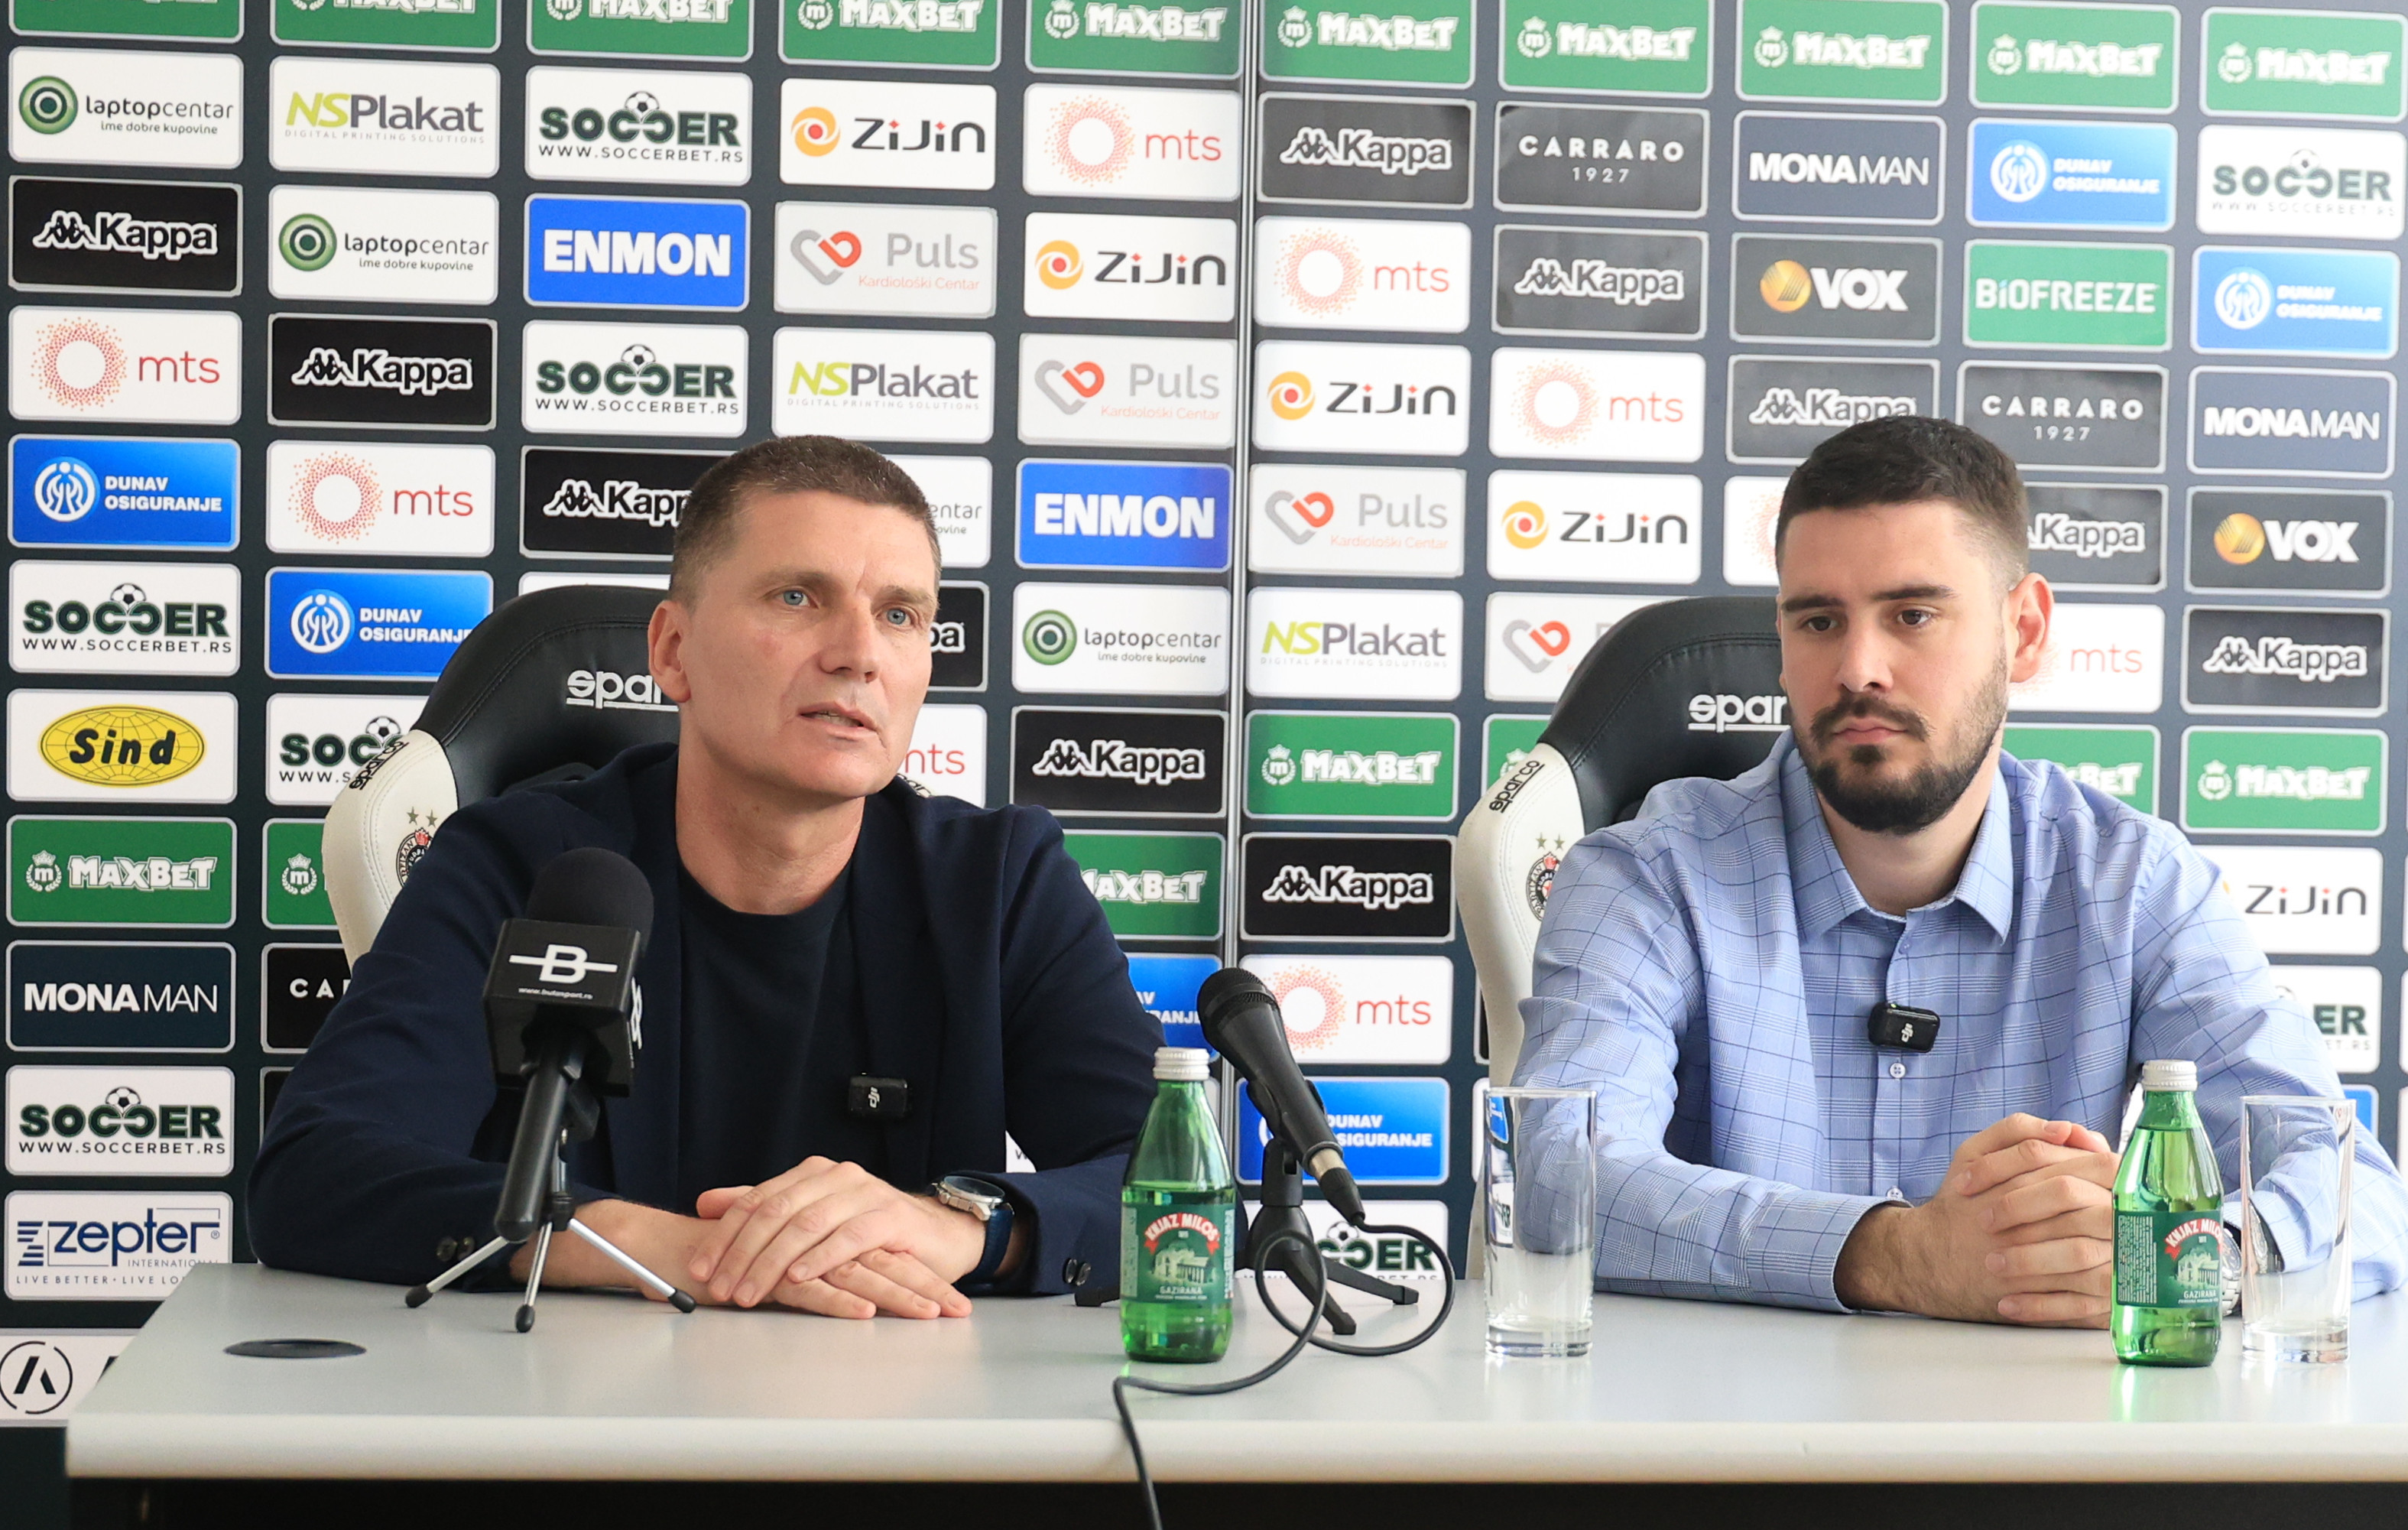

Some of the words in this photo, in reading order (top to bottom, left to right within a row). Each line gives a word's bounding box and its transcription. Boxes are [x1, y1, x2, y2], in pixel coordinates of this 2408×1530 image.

[840, 0, 982, 31] MAXBET
[1086, 3, 1227, 41] MAXBET
[1317, 12, 1459, 51] MAXBET
[1556, 22, 1696, 61] MAXBET
[1793, 31, 1931, 70] MAXBET
[2027, 39, 2163, 77] MAXBET
[2256, 47, 2391, 86] MAXBET
[86, 95, 234, 119] laptopcentar
[287, 93, 484, 132] NSPlakat
[101, 121, 122, 133] ime
[125, 121, 161, 134] dobre
[164, 122, 218, 136] kupovine
[285, 129, 337, 139] DIGITAL
[343, 132, 406, 141] PRINTING
[411, 134, 485, 144] SOLUTIONS
[539, 106, 741, 147] SOCCER
[538, 145, 743, 164] WWW.SOCCERBET.RS
[1146, 129, 1222, 161] mts
[1339, 129, 1452, 174] Kappa
[1518, 135, 1685, 163] CARRARO
[1572, 166, 1631, 184] 1927
[2053, 158, 2112, 174] DUNAV
[2053, 176, 2160, 196] OSIGURANJE
[2212, 164, 2393, 202] SOCCER
[96, 212, 218, 260] Kappa
[345, 232, 489, 257] laptopcentar
[887, 232, 979, 269] Puls
[359, 258, 381, 269] ime
[384, 259, 417, 271] dobre
[420, 260, 474, 273] kupovine
[544, 229, 731, 277] ENMON
[936, 276, 980, 291] Centar
[1374, 261, 1449, 292] mts
[1573, 260, 1684, 306] Kappa
[1811, 267, 1909, 311] VOX
[2277, 284, 2336, 301] DUNAV
[2277, 303, 2384, 321] OSIGURANJE
[139, 350, 221, 384] mts
[355, 349, 472, 396] Kappa
[537, 360, 737, 399] SOCCER
[788, 361, 979, 400] NSPlakat
[1129, 363, 1220, 400] Puls
[535, 397, 738, 415] WWW.SOCCERBET.RS
[787, 398, 839, 408] DIGITAL
[842, 399, 904, 409] PRINTING
[908, 401, 979, 411] SOLUTIONS
[1176, 407, 1220, 421] Centar
[1609, 391, 1684, 422] mts
[1981, 395, 2144, 421] CARRARO
[2033, 424, 2091, 442] 1927
[105, 475, 168, 492] DUNAV
[105, 494, 222, 513] OSIGURANJE
[394, 485, 474, 516] mts
[1034, 493, 1216, 539] ENMON
[1358, 493, 1449, 528] Puls
[936, 525, 966, 534] ovine
[1405, 536, 1449, 550] Centar
[2034, 513, 2145, 558] Kappa
[2263, 519, 2361, 563] VOX
[24, 600, 227, 637] SOCCER
[360, 607, 422, 624] DUNAV
[22, 638, 232, 654] WWW.SOCCERBET.RS
[1084, 625, 1222, 650] laptopcentar
[1262, 622, 1446, 657] NSPlakat
[1098, 651, 1116, 662] ime
[1121, 651, 1153, 663] dobre
[1156, 652, 1206, 665] kupovine
[1260, 657, 1309, 665] DIGITAL
[1314, 658, 1374, 667] PRINTING
[1378, 659, 1447, 668] SOLUTIONS
[2070, 644, 2143, 674] mts
[2259, 638, 2368, 682] Kappa
[566, 668, 664, 709] spar
[1688, 694, 1788, 733] spar
[69, 728, 177, 765] Sind
[1091, 740, 1205, 785] Kappa
[1301, 749, 1442, 786] MAXBET
[1489, 760, 1545, 814] sparco
[2236, 764, 2371, 801] MAXBET
[68, 855, 218, 892] MAXBET
[1322, 866, 1433, 910] Kappa
[1356, 995, 1431, 1025] mts
[19, 1103, 224, 1139] SOCCER
[19, 1142, 226, 1155] WWW.SOCCERBET.RS
[1338, 1132, 1433, 1147] SIGURANJE
[47, 1208, 220, 1267] zepter
[1144, 1213, 1180, 1241] KNJAZ
[2165, 1220, 2199, 1248] KNJAZ
[2201, 1218, 2222, 1240] MILO
[128, 1259, 219, 1269] INTERNATIO
[1318, 1238, 1435, 1270] CCER
[16, 1275, 48, 1284] LIVE
[55, 1276, 109, 1285] BETTER
[122, 1276, 154, 1285] LIVE
[2183, 1289, 2216, 1299] GAZIRANA
